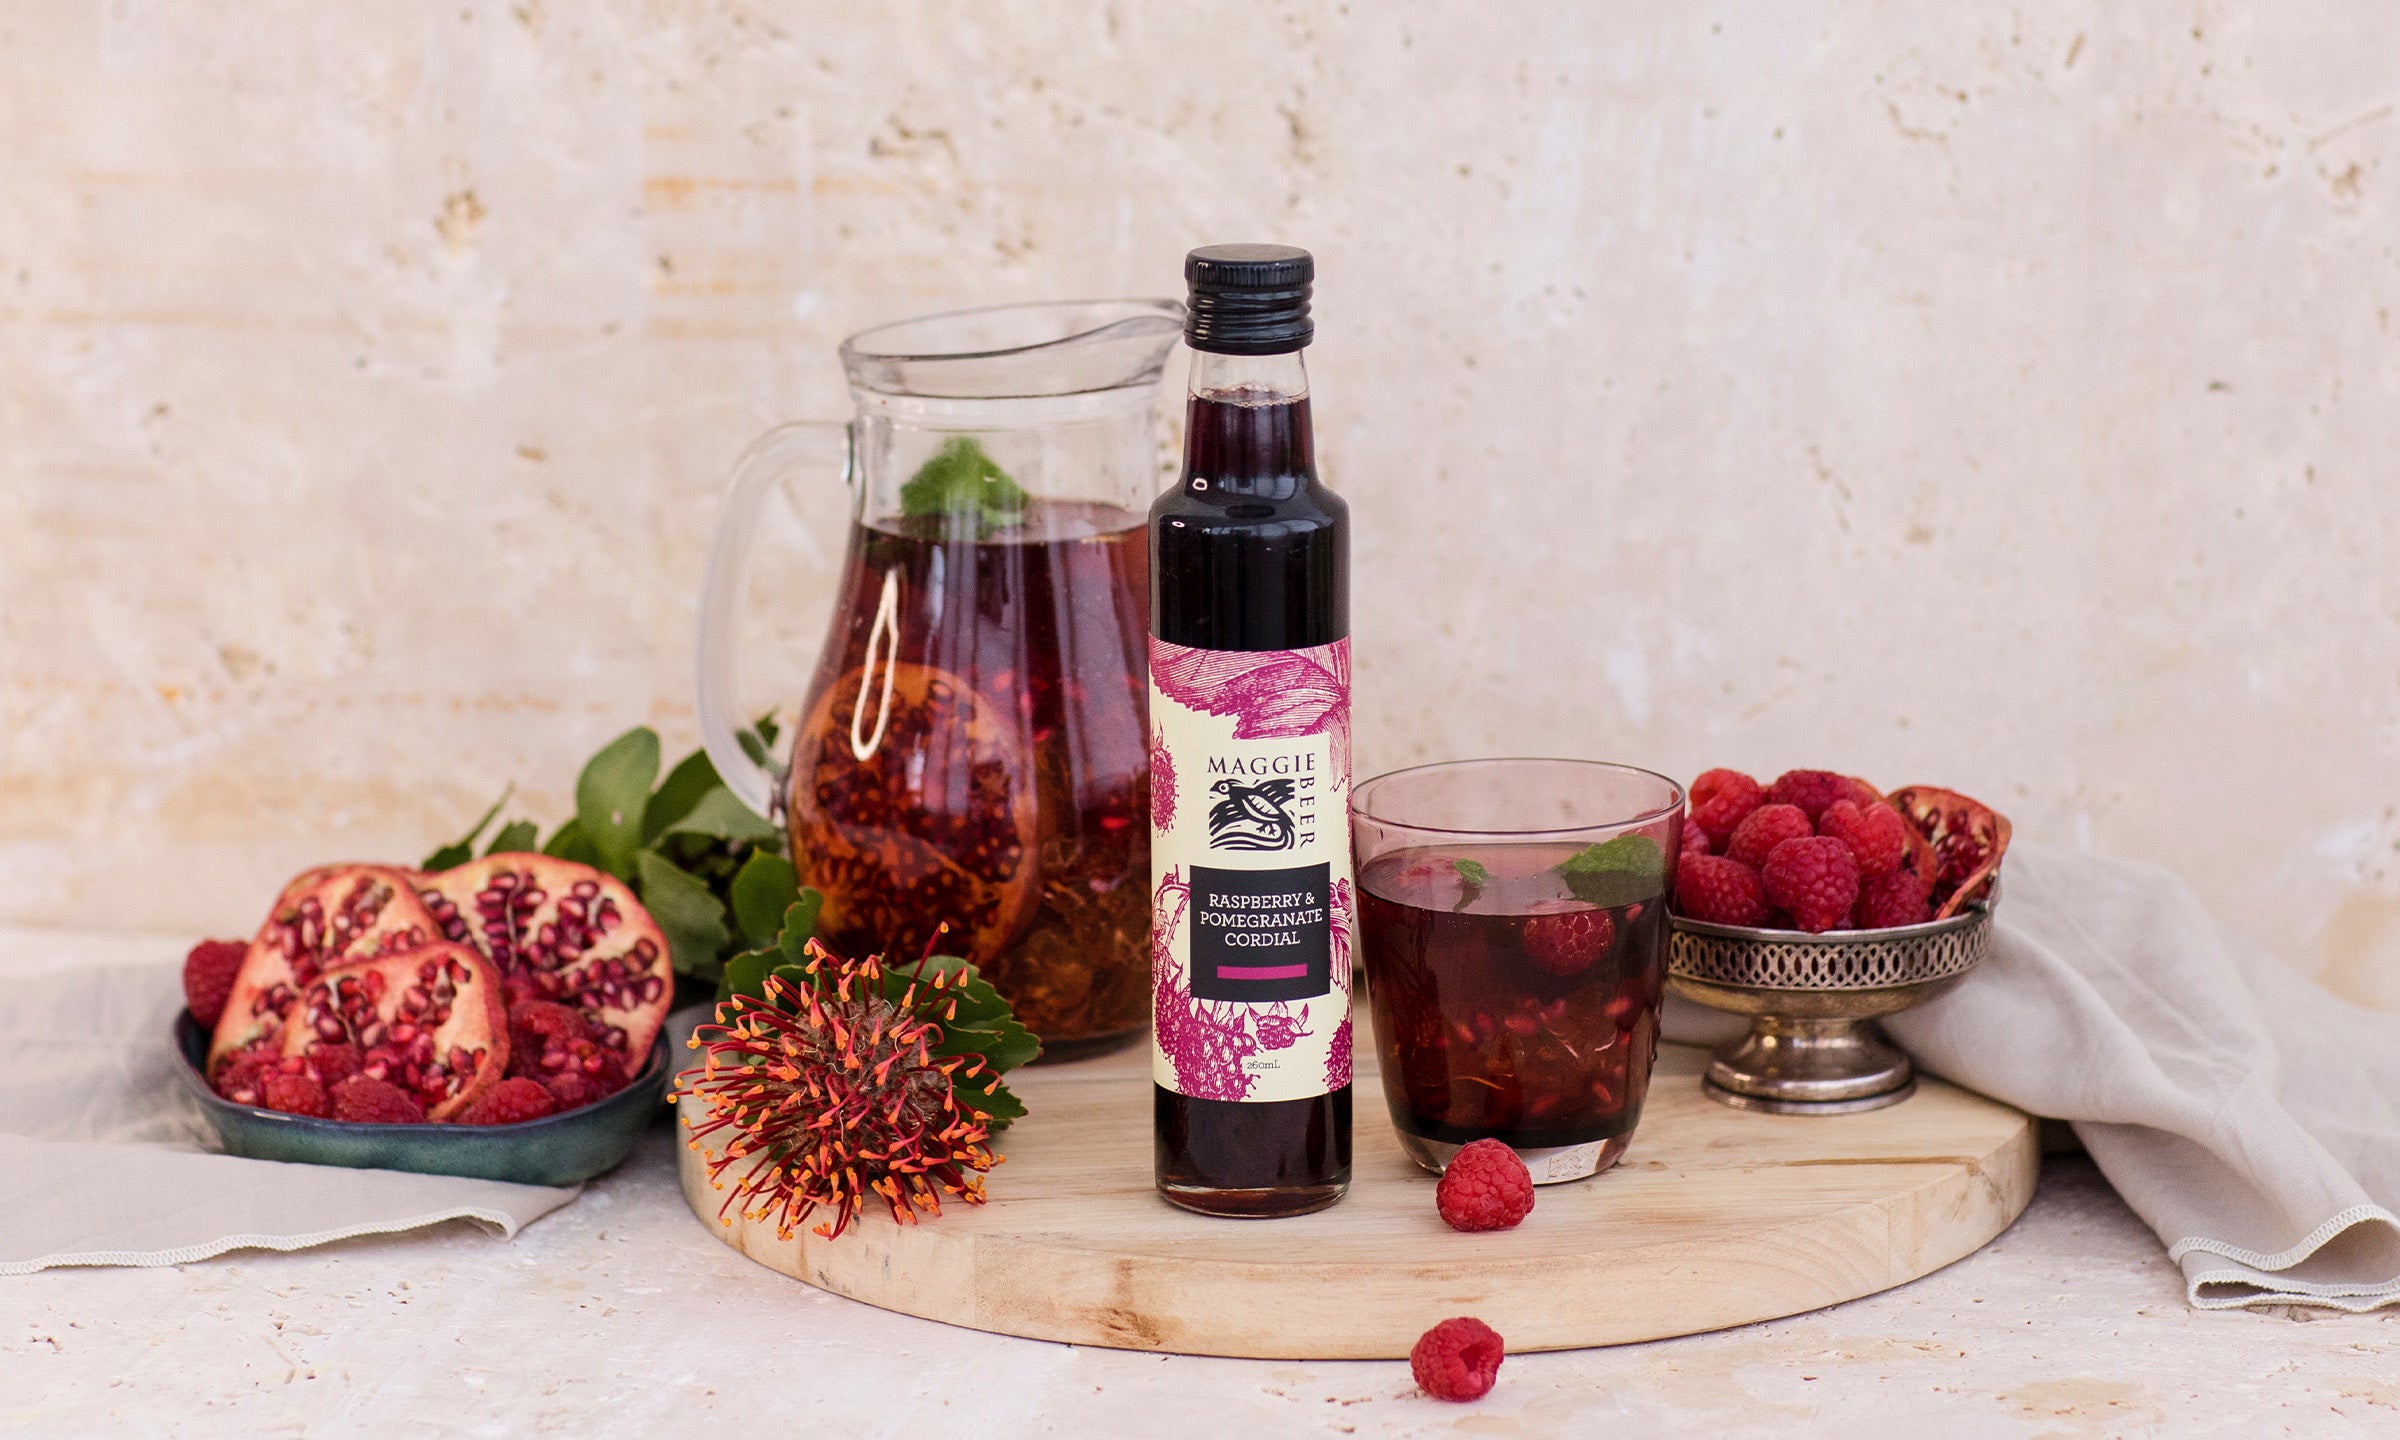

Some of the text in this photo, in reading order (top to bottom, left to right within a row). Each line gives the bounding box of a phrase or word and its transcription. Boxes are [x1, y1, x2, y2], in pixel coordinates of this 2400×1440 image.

[1207, 752, 1315, 775] MAGGIE
[1300, 776, 1315, 849] BEER
[1209, 891, 1315, 909] RASPBERRY &
[1200, 908, 1323, 928] POMEGRANATE
[1225, 931, 1301, 947] CORDIAL
[1246, 1060, 1281, 1070] 260mL
